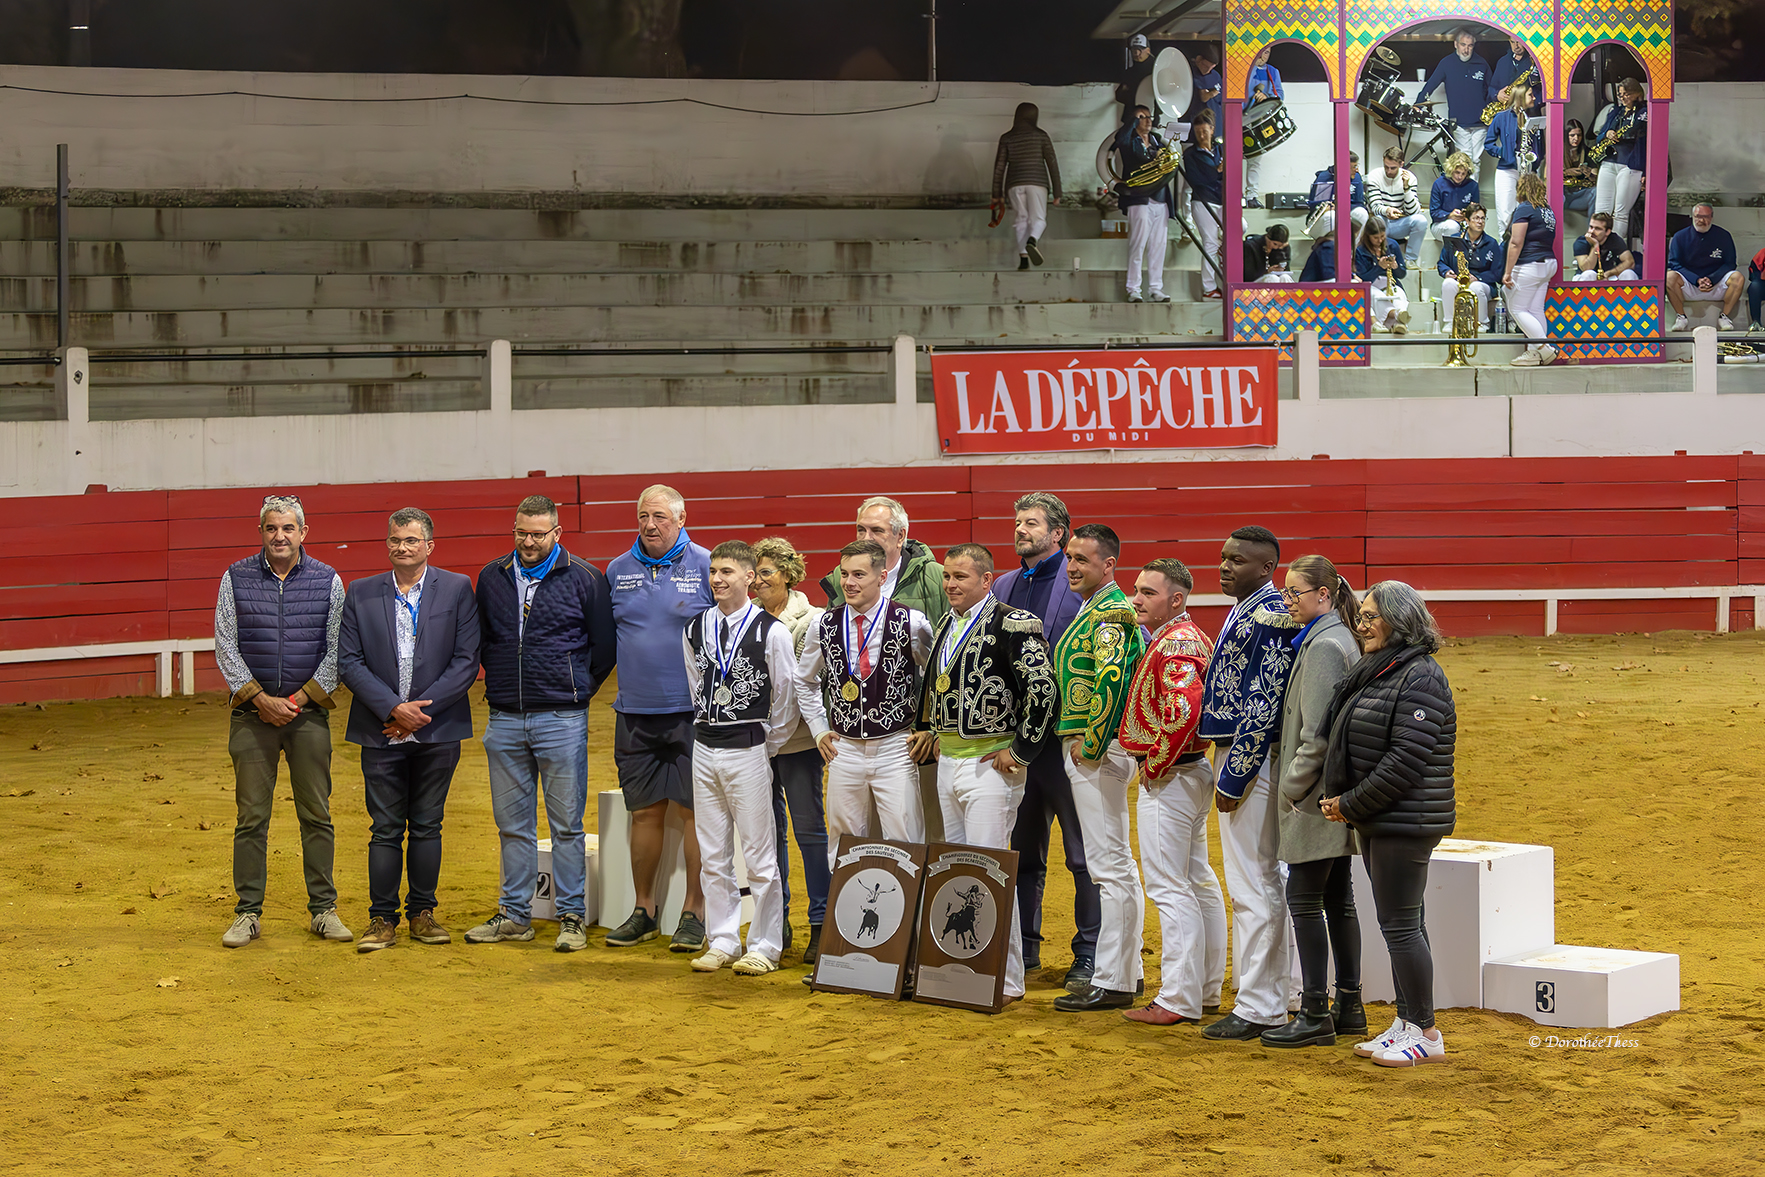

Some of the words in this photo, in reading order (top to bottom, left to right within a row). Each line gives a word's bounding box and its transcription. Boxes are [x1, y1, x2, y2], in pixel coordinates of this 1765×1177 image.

[951, 370, 1023, 433] LA
[1023, 357, 1262, 432] DÉPÊCHE
[1072, 432, 1094, 442] DU
[1108, 431, 1149, 441] MIDI
[852, 845, 884, 853] CHAMPIONNAT
[890, 847, 909, 859] SECONDE
[874, 850, 895, 858] SAUTEURS
[537, 873, 550, 898] 2
[1537, 982, 1554, 1012] 3
